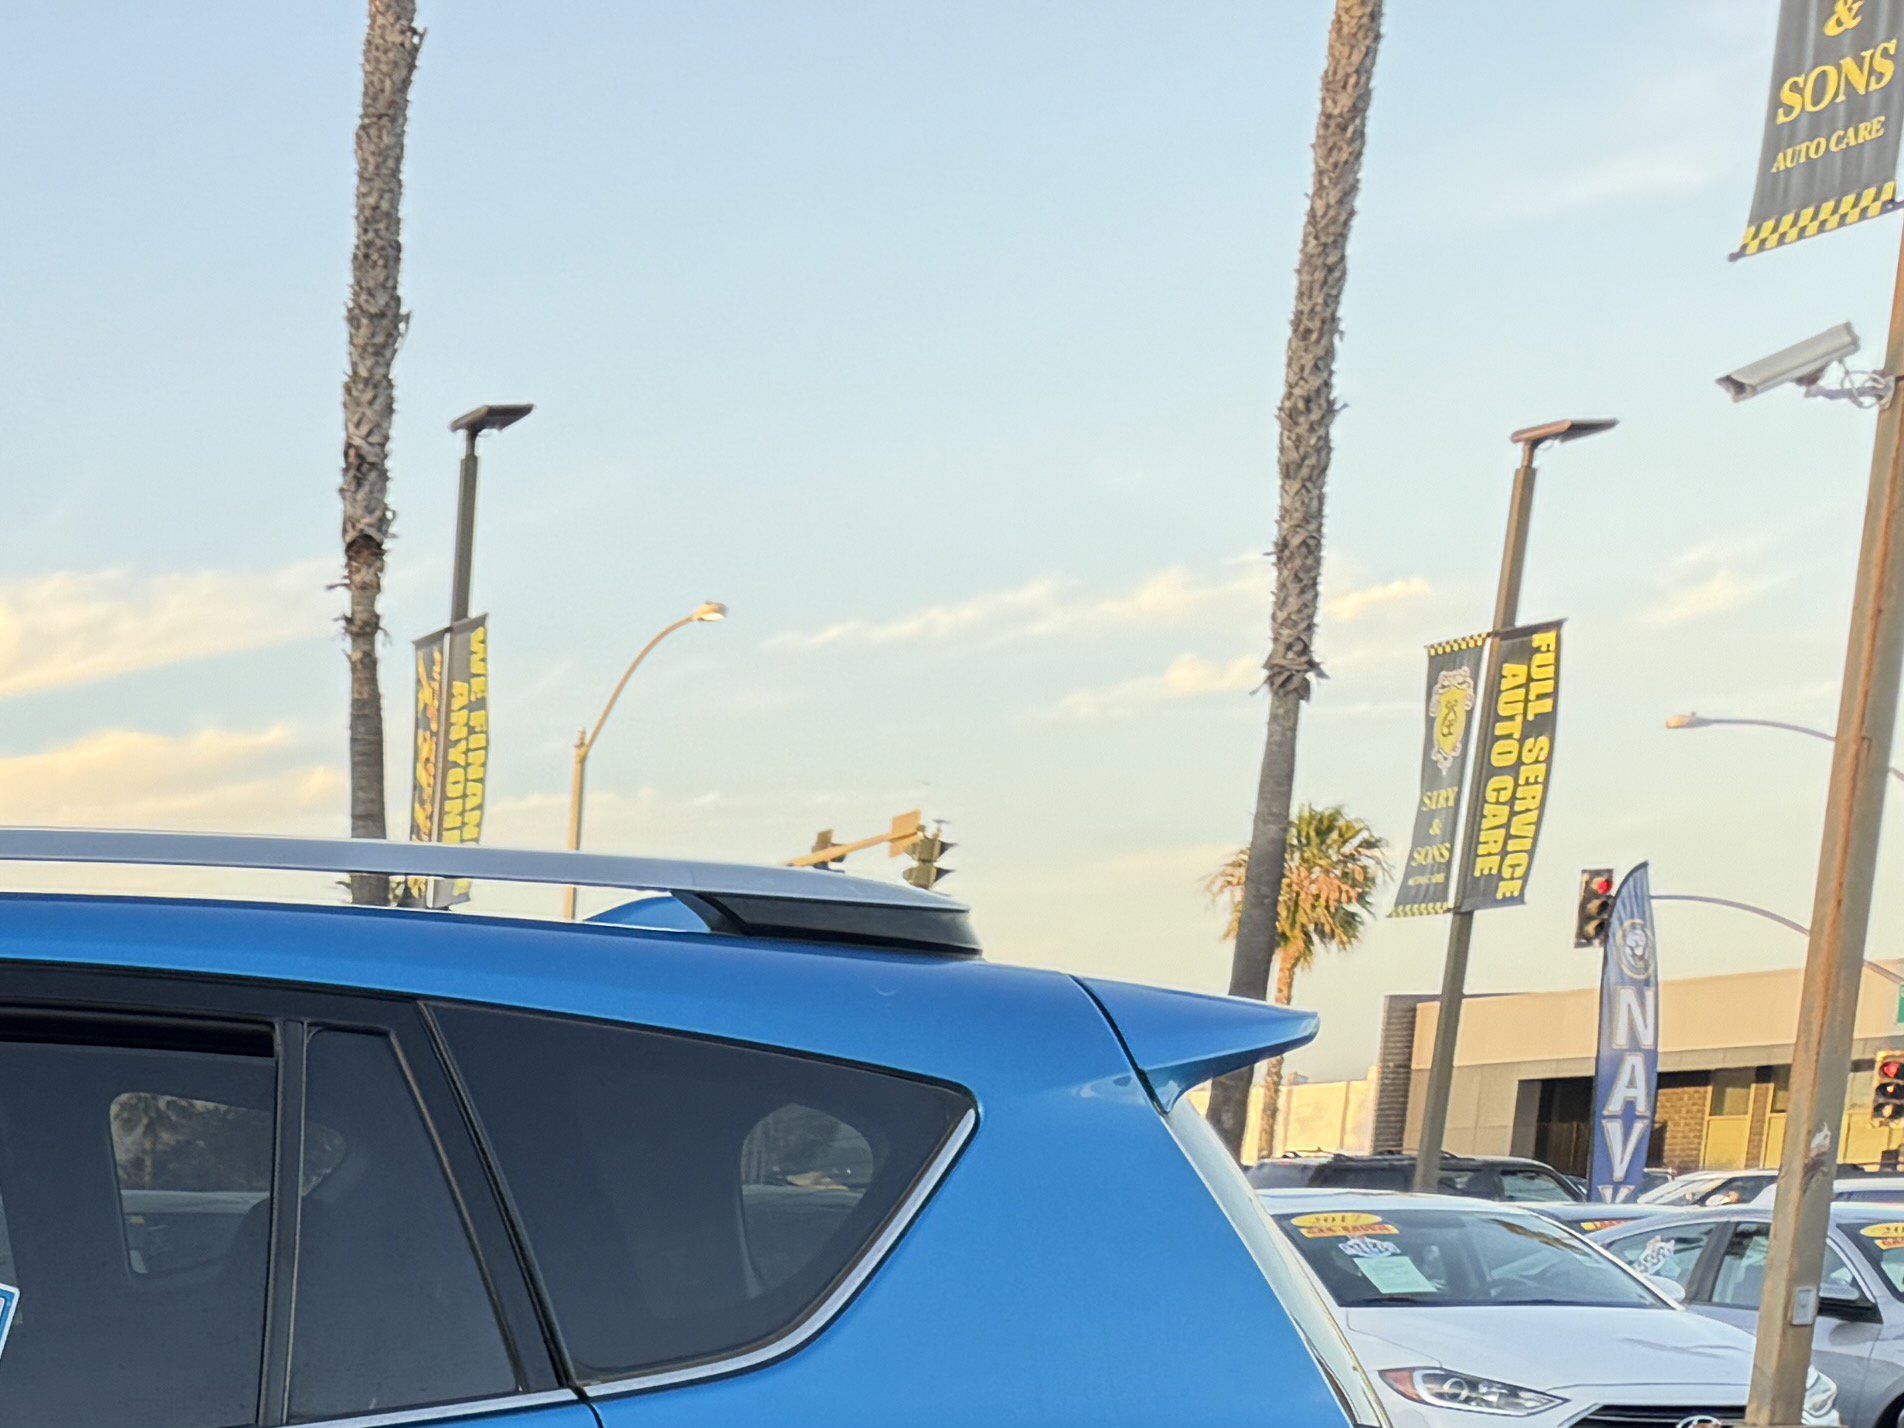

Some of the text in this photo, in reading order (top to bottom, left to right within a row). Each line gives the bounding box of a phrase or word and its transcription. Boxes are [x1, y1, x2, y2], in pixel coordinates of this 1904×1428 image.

[1824, 0, 1864, 36] &
[1776, 39, 1897, 125] SONS
[1770, 116, 1886, 173] AUTO CARE
[470, 626, 487, 702] WE
[1473, 663, 1528, 877] AUTO CARE
[1496, 630, 1557, 900] FULL SERVICE
[1420, 786, 1459, 812] SIRY
[1410, 842, 1451, 866] SONS
